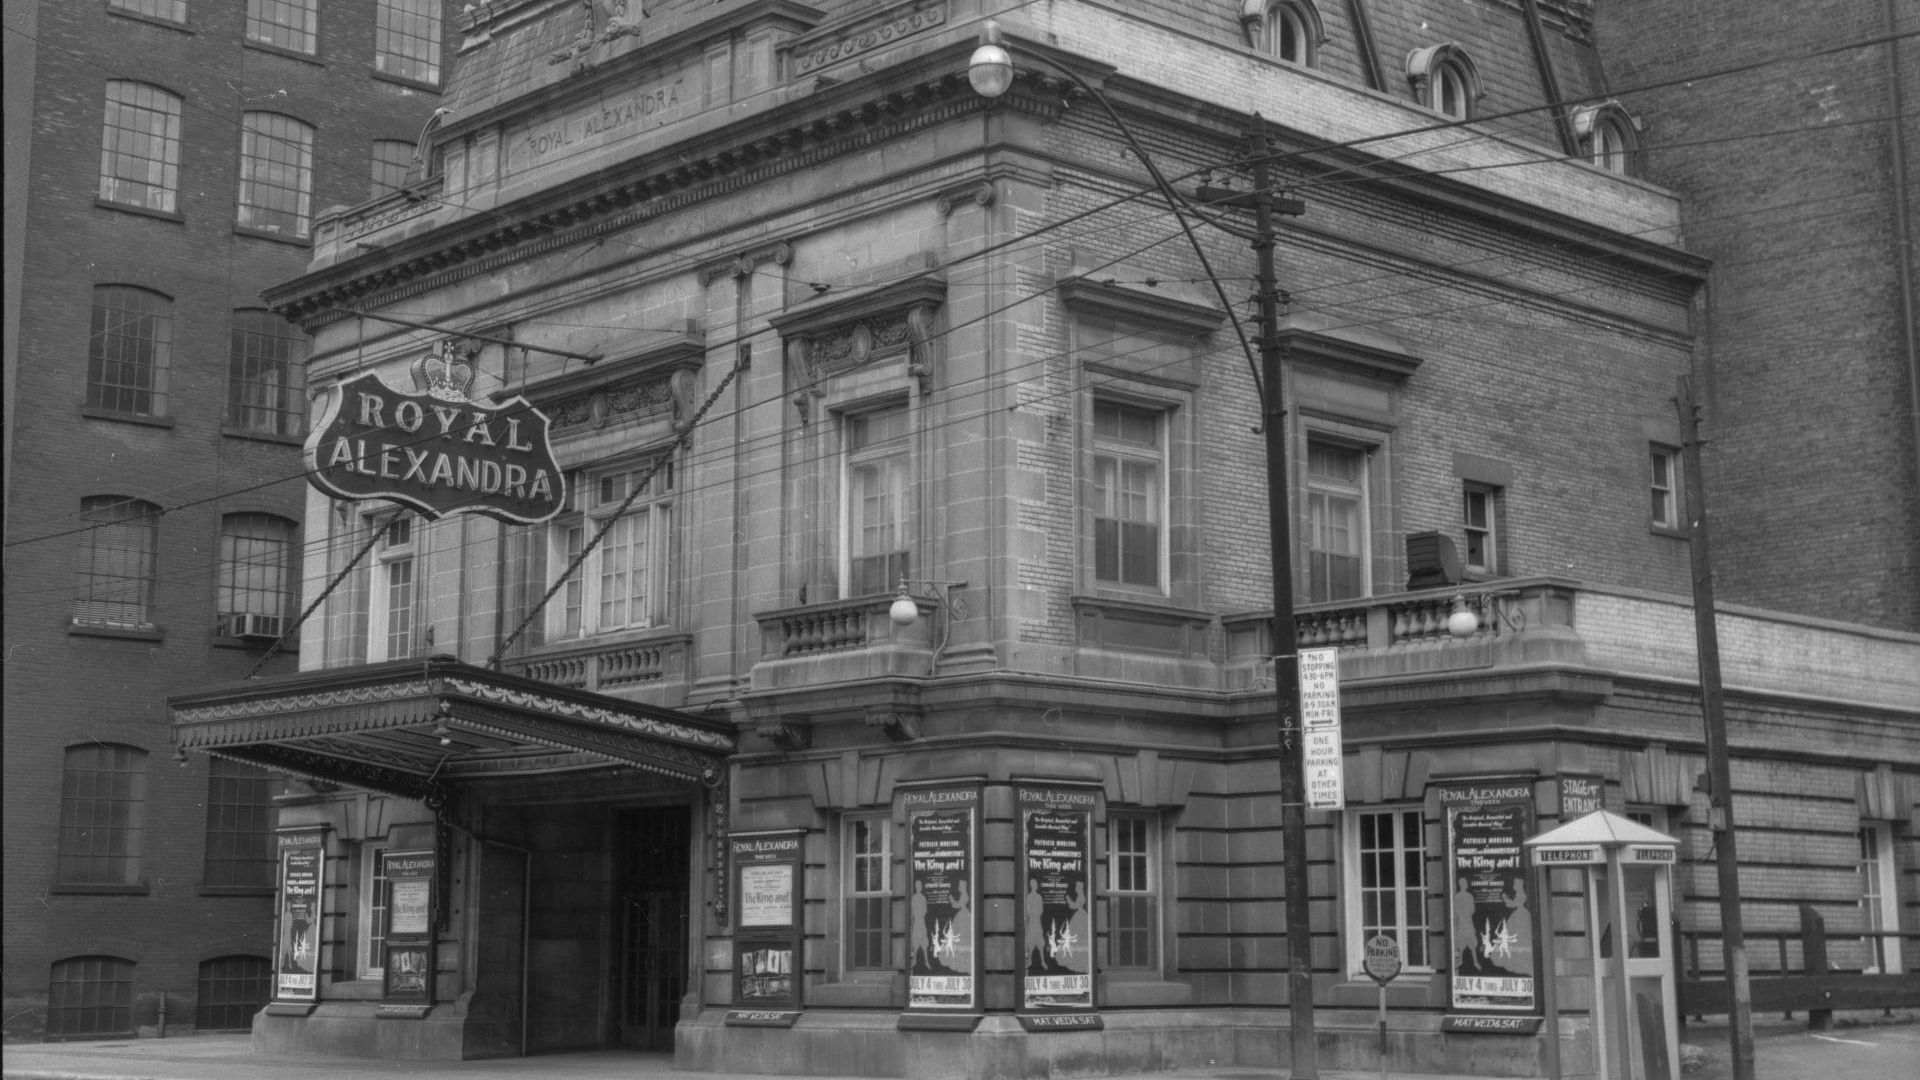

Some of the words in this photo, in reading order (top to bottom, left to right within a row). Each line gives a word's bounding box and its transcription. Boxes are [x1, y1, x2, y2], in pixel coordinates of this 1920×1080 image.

[528, 124, 573, 157] ROYAL
[583, 87, 679, 139] ALEXANDRA
[357, 392, 532, 453] ROYAL
[329, 436, 553, 502] ALEXANDRA
[1303, 662, 1335, 672] STOPPING
[1314, 682, 1325, 690] NO
[1304, 691, 1336, 700] PARKING
[1314, 736, 1329, 745] ONE
[1311, 747, 1335, 756] HOUR
[1307, 758, 1339, 767] PARKING
[1318, 769, 1327, 778] AT
[1312, 780, 1337, 789] OTHER
[1563, 779, 1588, 796] STAGE
[904, 792, 928, 804] ROYAL
[928, 791, 978, 805] ALEXANDRA
[1020, 788, 1046, 802] ROYAL
[1046, 790, 1096, 805] ALEXANDRA
[1313, 792, 1338, 800] TIMES
[1440, 789, 1470, 802] ROYAL
[1470, 788, 1530, 802] ALEXANDRA
[1563, 797, 1600, 813] ENTRANCE
[734, 842, 754, 853] ROYAL
[756, 840, 798, 852] ALEXANDRA
[1543, 851, 1593, 861] TELEPHONE
[1636, 850, 1673, 861] TELEPHONE
[914, 860, 926, 871] The
[926, 859, 945, 872] King
[946, 859, 960, 870] and
[960, 859, 964, 870] I
[1029, 858, 1042, 869] The
[1042, 858, 1062, 872] King
[1062, 860, 1076, 871] and
[1078, 860, 1082, 871] I
[1457, 856, 1472, 868] The
[1472, 856, 1494, 872] King
[1496, 856, 1514, 868] and
[1515, 856, 1520, 868] I
[1376, 938, 1388, 947] NO
[1366, 945, 1398, 958] PARKING
[1025, 976, 1040, 990] JULY
[1042, 976, 1048, 990] 4
[1062, 976, 1079, 990] JULY
[1080, 976, 1089, 989] 30
[1456, 978, 1474, 991] JULY
[1476, 978, 1482, 991] 4
[1500, 978, 1518, 992] JULY
[1521, 979, 1533, 993] 30
